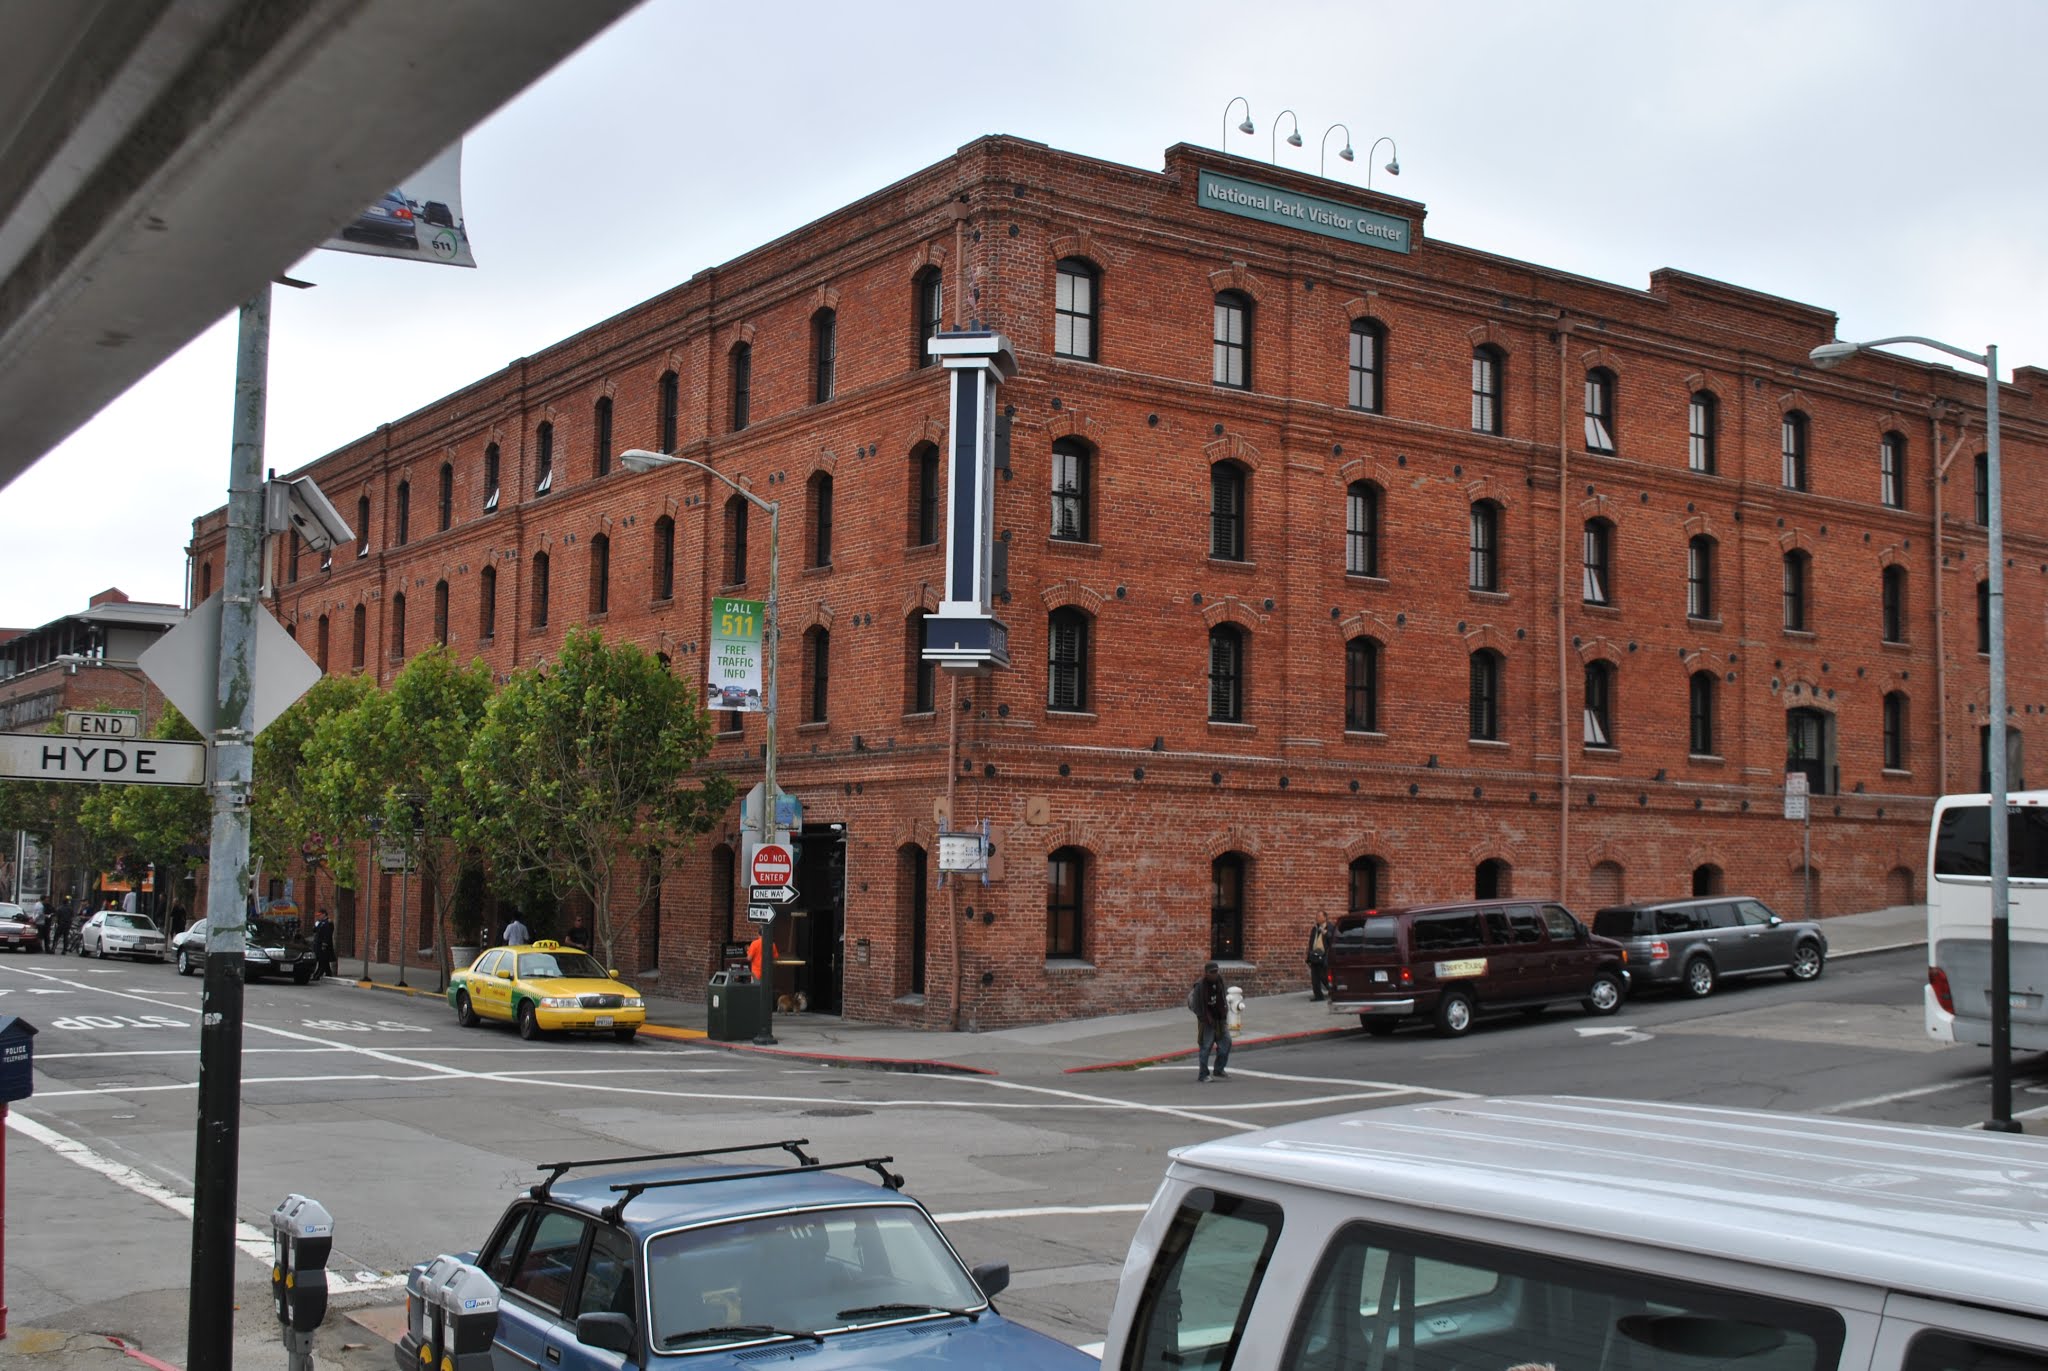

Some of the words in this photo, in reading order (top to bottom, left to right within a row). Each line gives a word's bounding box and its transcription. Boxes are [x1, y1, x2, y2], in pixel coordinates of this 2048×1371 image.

[1207, 183, 1270, 210] National
[1273, 198, 1304, 219] Park
[1309, 208, 1353, 230] Visitor
[1356, 219, 1402, 241] Center
[432, 240, 451, 251] 511
[725, 602, 752, 615] CALL
[722, 614, 753, 637] 511
[725, 645, 746, 656] FREE
[717, 656, 754, 668] TRAFFIC
[724, 668, 746, 679] INFO
[80, 717, 122, 734] END
[42, 746, 157, 774] HYDE
[758, 854, 768, 862] DO
[772, 854, 786, 863] NOT
[760, 873, 784, 882] ENTER
[755, 890, 769, 898] ONE
[5, 1045, 26, 1055] POLICE
